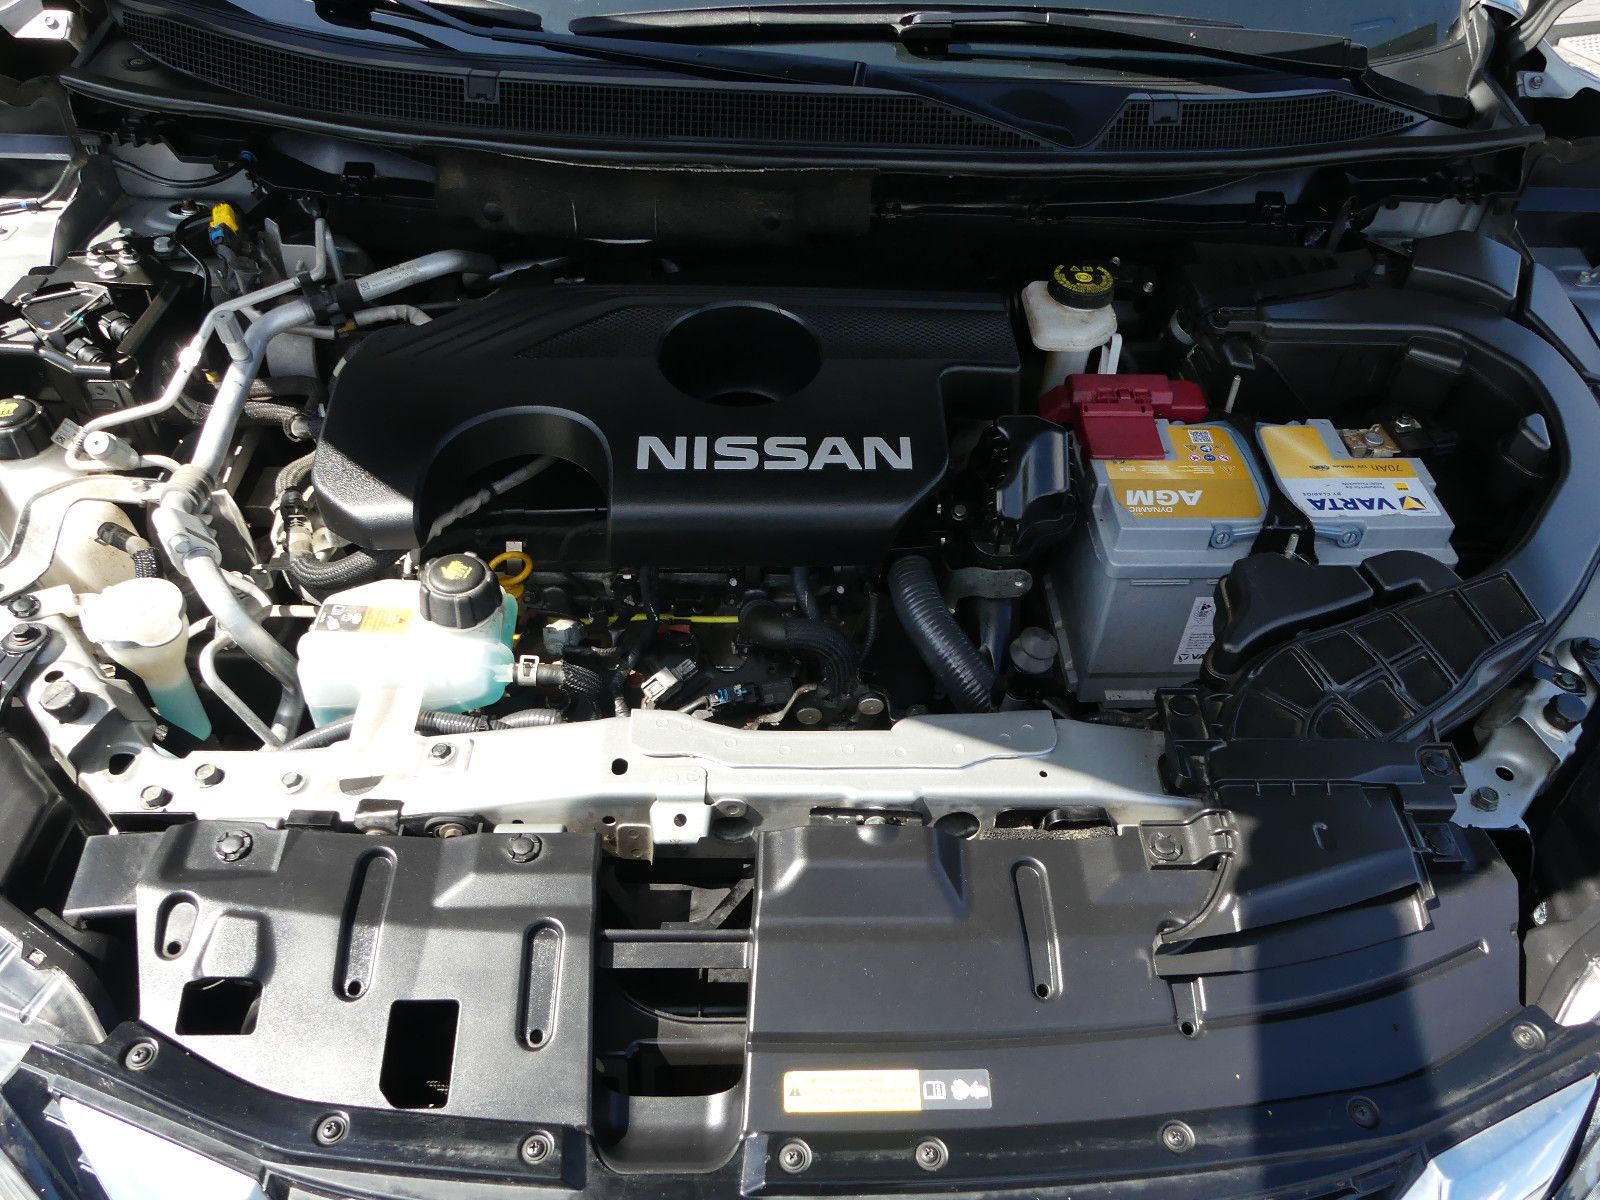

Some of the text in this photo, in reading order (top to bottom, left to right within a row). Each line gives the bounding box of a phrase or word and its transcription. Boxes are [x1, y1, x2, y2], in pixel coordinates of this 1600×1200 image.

[637, 436, 912, 470] NISSAN
[1370, 464, 1403, 472] 70Ah
[1126, 489, 1203, 506] AGM
[1306, 497, 1397, 511] VARTA
